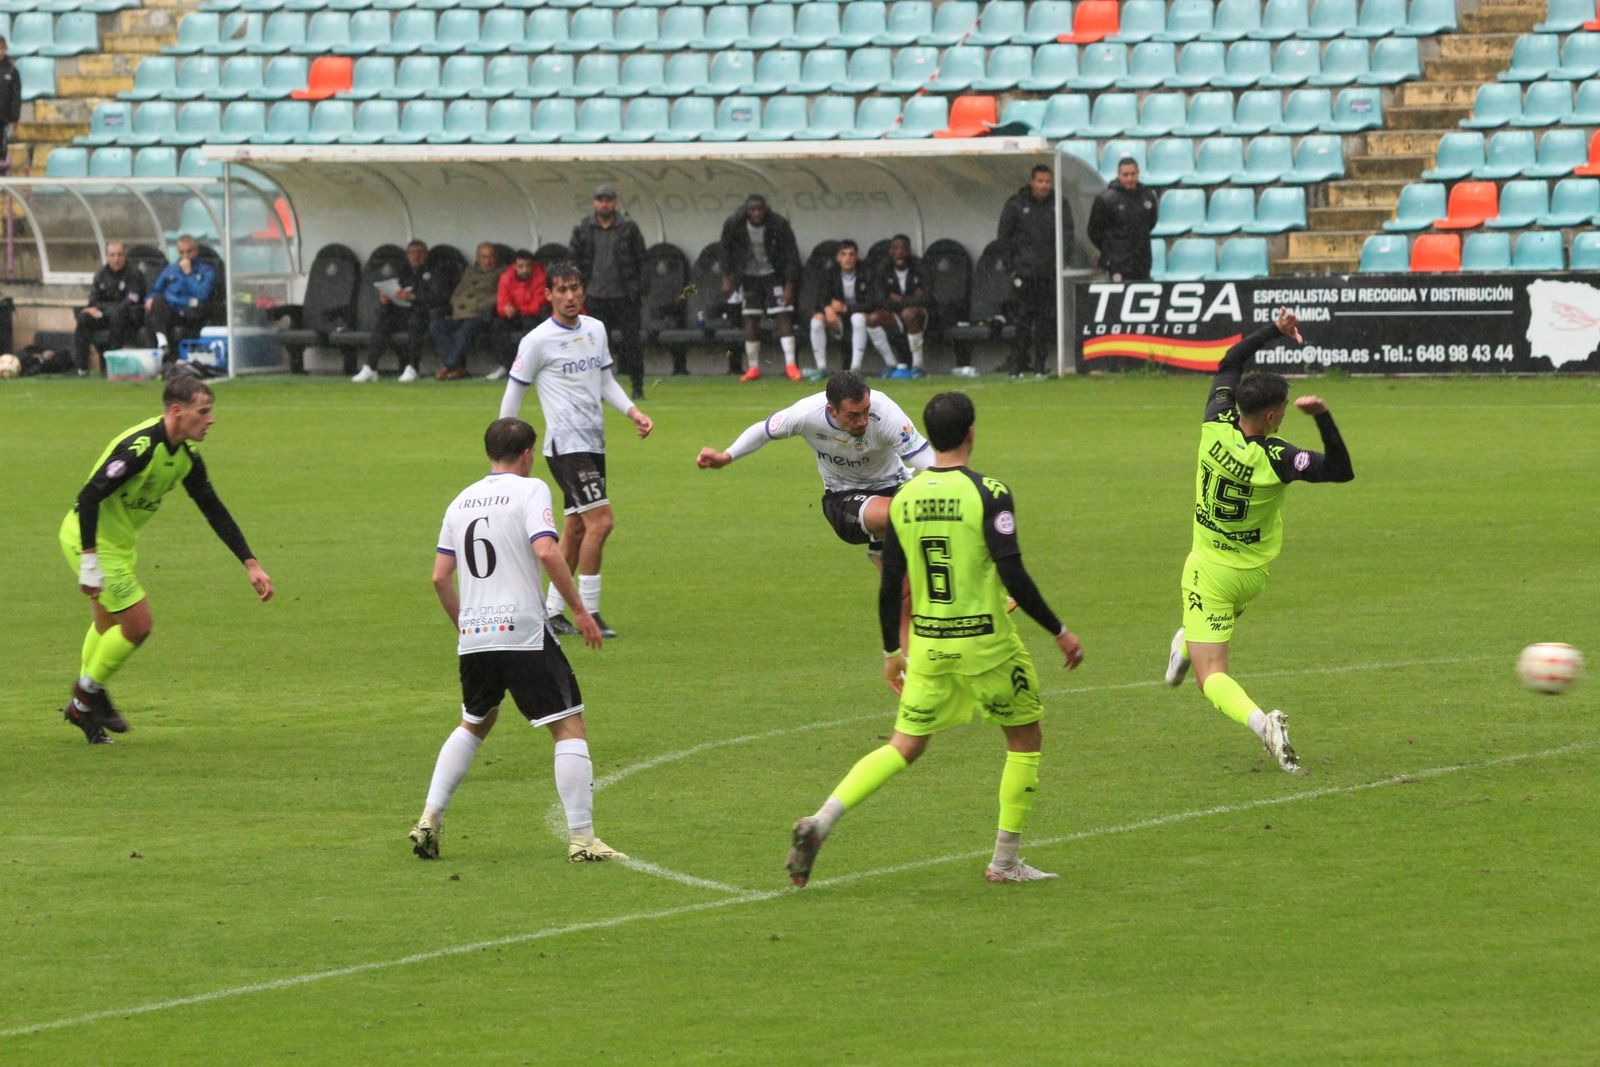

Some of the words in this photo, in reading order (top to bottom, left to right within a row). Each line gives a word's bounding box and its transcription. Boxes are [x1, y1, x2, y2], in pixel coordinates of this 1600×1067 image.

[1088, 283, 1243, 323] TGSA
[1253, 288, 1339, 303] ESPECIALISTAS
[1341, 288, 1356, 302] EN
[1358, 287, 1418, 302] RECOGIDA
[1419, 287, 1428, 302] Y
[1430, 284, 1514, 302] DISTRIBUCIÓN
[1253, 307, 1269, 322] DE
[1271, 305, 1331, 322] CÁMICA
[1083, 324, 1198, 335] LOGISTICS
[1255, 345, 1369, 366] trafico@tgsa.es
[1381, 344, 1413, 362] Tel.:
[1416, 344, 1445, 362] 648
[1448, 344, 1468, 362] 98
[1471, 344, 1491, 362] 43
[1494, 343, 1514, 362] 44
[562, 356, 601, 375] meins
[816, 450, 870, 468] meins
[582, 483, 602, 501] 15
[1201, 460, 1254, 522] 15
[464, 515, 497, 579] 6
[919, 536, 954, 604] 6
[479, 603, 516, 618] grupo
